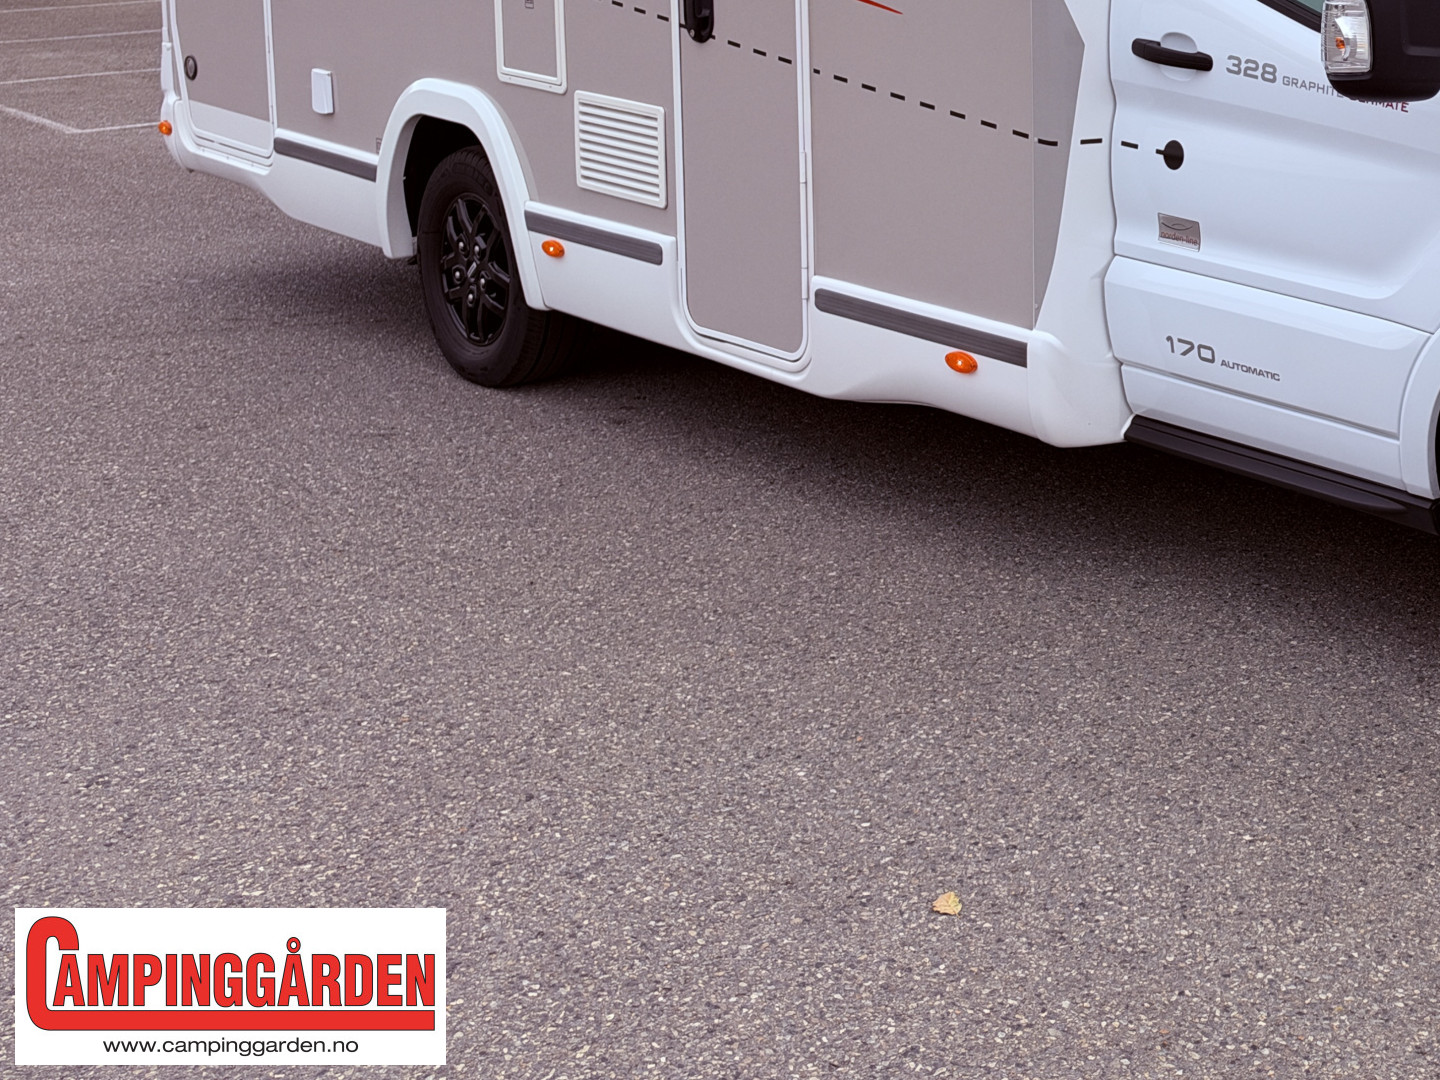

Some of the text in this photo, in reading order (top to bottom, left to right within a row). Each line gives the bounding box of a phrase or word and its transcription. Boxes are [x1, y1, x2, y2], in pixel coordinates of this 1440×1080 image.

[1226, 54, 1278, 84] 328
[1165, 335, 1281, 382] 170 AUTOMATIC
